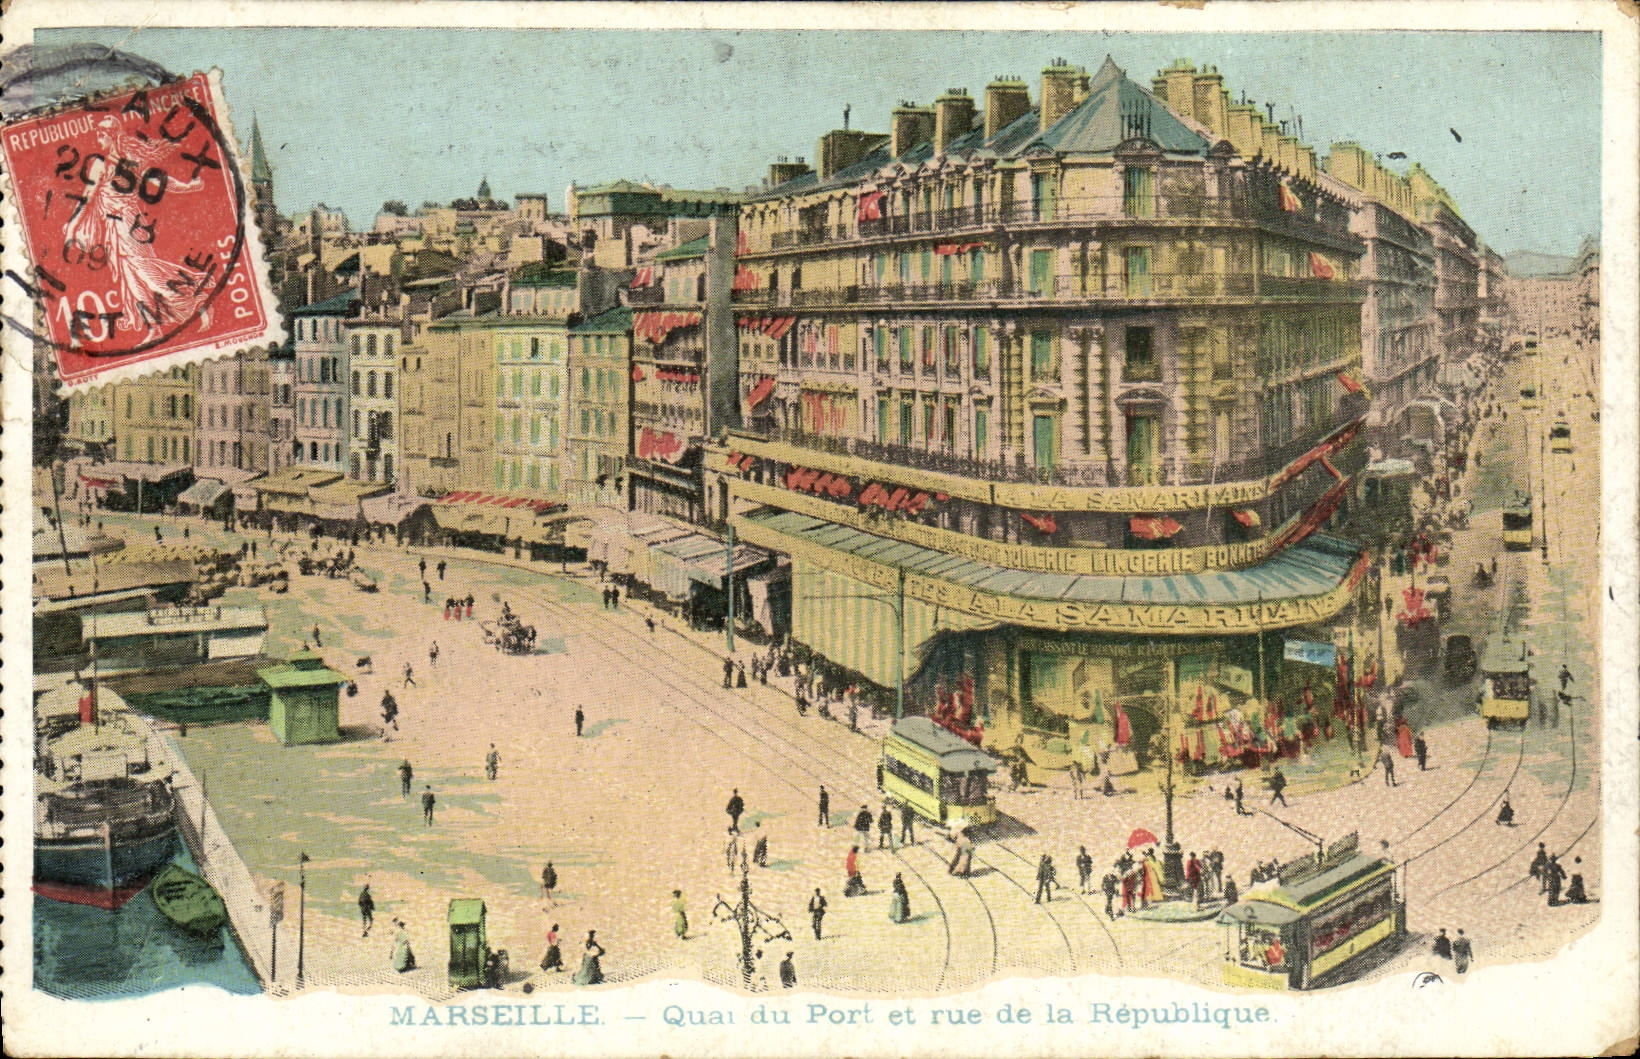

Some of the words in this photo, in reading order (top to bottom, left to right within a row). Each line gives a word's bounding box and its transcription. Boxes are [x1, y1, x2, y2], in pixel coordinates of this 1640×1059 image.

[9, 113, 97, 152] REPUBLIQUE
[1091, 551, 1192, 575] LINGERIE
[996, 598, 1048, 623] LA
[1055, 596, 1337, 629] SAMARITAINE
